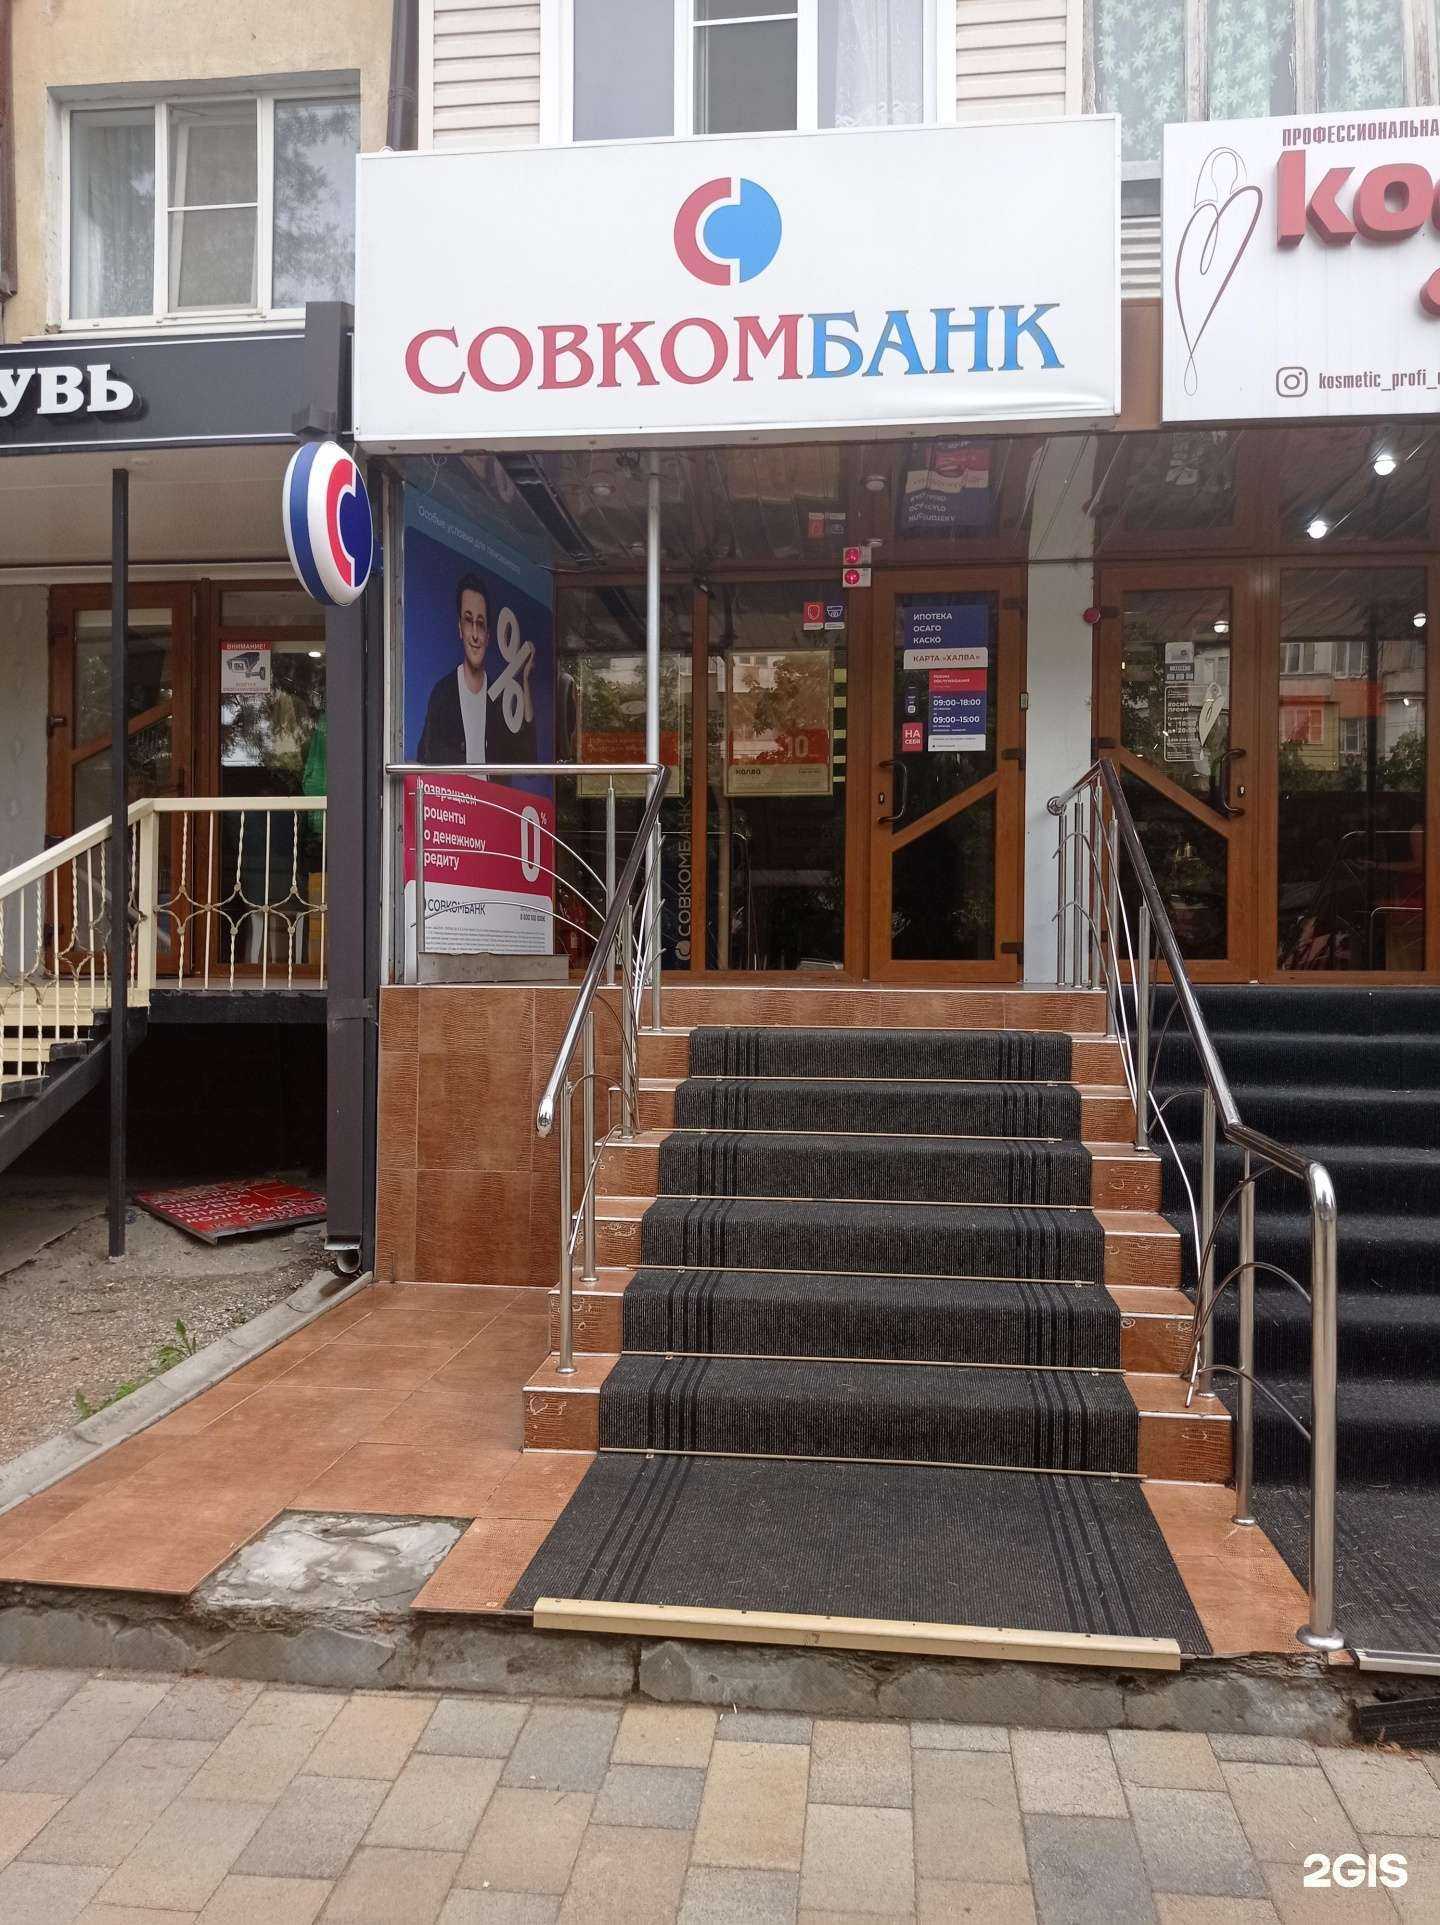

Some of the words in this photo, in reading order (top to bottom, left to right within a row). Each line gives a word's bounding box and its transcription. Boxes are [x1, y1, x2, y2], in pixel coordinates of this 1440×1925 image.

[1277, 149, 1440, 250] ко
[404, 302, 1065, 395] СОВКОМБАНК
[0, 363, 134, 418] УВЬ
[913, 612, 953, 621] ИПОТЕКА
[913, 624, 942, 632] ОСАГО
[913, 636, 942, 644] КАСКО
[913, 655, 940, 663] КАРТА
[904, 729, 921, 739] НА
[424, 805, 466, 825] роценты
[424, 830, 430, 840] о
[432, 831, 486, 851] денежному
[424, 851, 460, 871] редиту
[678, 801, 691, 936] СОВКОМБАНК
[428, 898, 486, 916] СОВКОМБАНК
